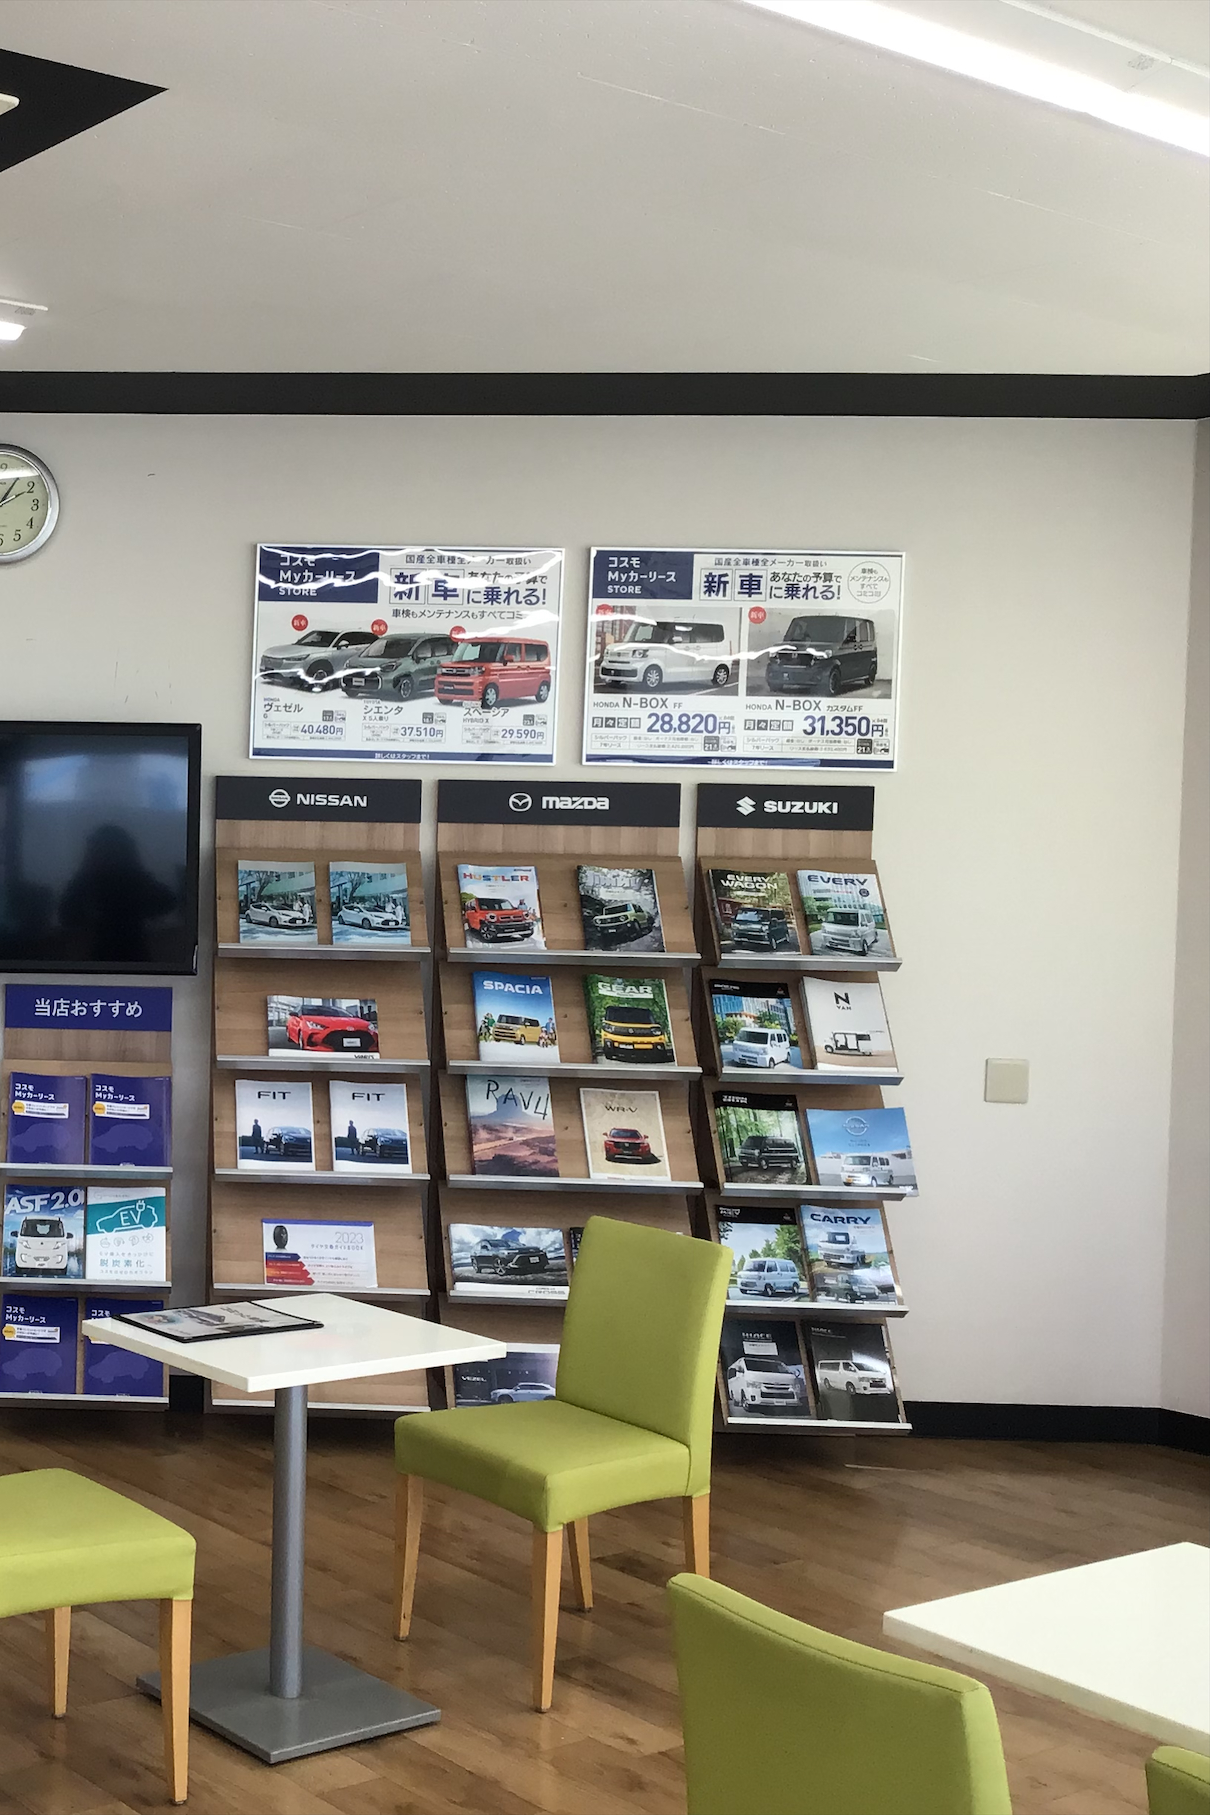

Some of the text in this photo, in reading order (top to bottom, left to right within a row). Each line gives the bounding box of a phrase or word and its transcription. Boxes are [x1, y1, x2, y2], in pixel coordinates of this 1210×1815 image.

[26, 481, 35, 494] 2
[31, 498, 40, 511] 3
[26, 517, 34, 529] 4
[13, 529, 22, 542] 5
[280, 554, 316, 566] コスモ
[609, 556, 640, 568] コスモ
[714, 558, 828, 568] 国産全車種全メーカー取扱い
[608, 570, 676, 582] Myカーリース
[770, 572, 842, 582] あなたの予算で
[607, 586, 642, 594] STORE
[704, 572, 763, 598] 新車
[278, 587, 317, 596] STORE
[467, 587, 546, 606] に乗れる!
[770, 584, 841, 600] に乗れる!
[264, 702, 303, 713] ヴェゼル
[622, 697, 668, 709] N-BOX
[775, 700, 822, 712] N-BOX
[364, 705, 404, 715] シエンタ
[296, 794, 368, 807] NISSAN
[764, 800, 838, 814] SUZUKI
[463, 872, 530, 882] HUSTLER
[726, 874, 770, 883] EVERY
[808, 875, 868, 886] EVERY
[721, 880, 778, 890] WAGON
[483, 980, 543, 994] SPACIA
[598, 982, 653, 994] GEAR
[834, 992, 850, 1005] N
[34, 998, 143, 1018] 当店おすすめ
[15, 1083, 34, 1091] コスモ
[14, 1091, 54, 1100] Myカーリース
[95, 1092, 136, 1101] Myカーリース
[257, 1092, 291, 1100] FIT
[352, 1092, 386, 1102] FIT
[486, 1080, 550, 1120] RAV4
[604, 1105, 638, 1113] WR-V
[5, 1193, 50, 1214] ASF
[120, 1210, 141, 1226] EV
[810, 1214, 872, 1225] CARRY
[335, 1232, 364, 1244] 2023
[6, 1306, 26, 1314] コスモ
[6, 1314, 46, 1324] Myカーリース
